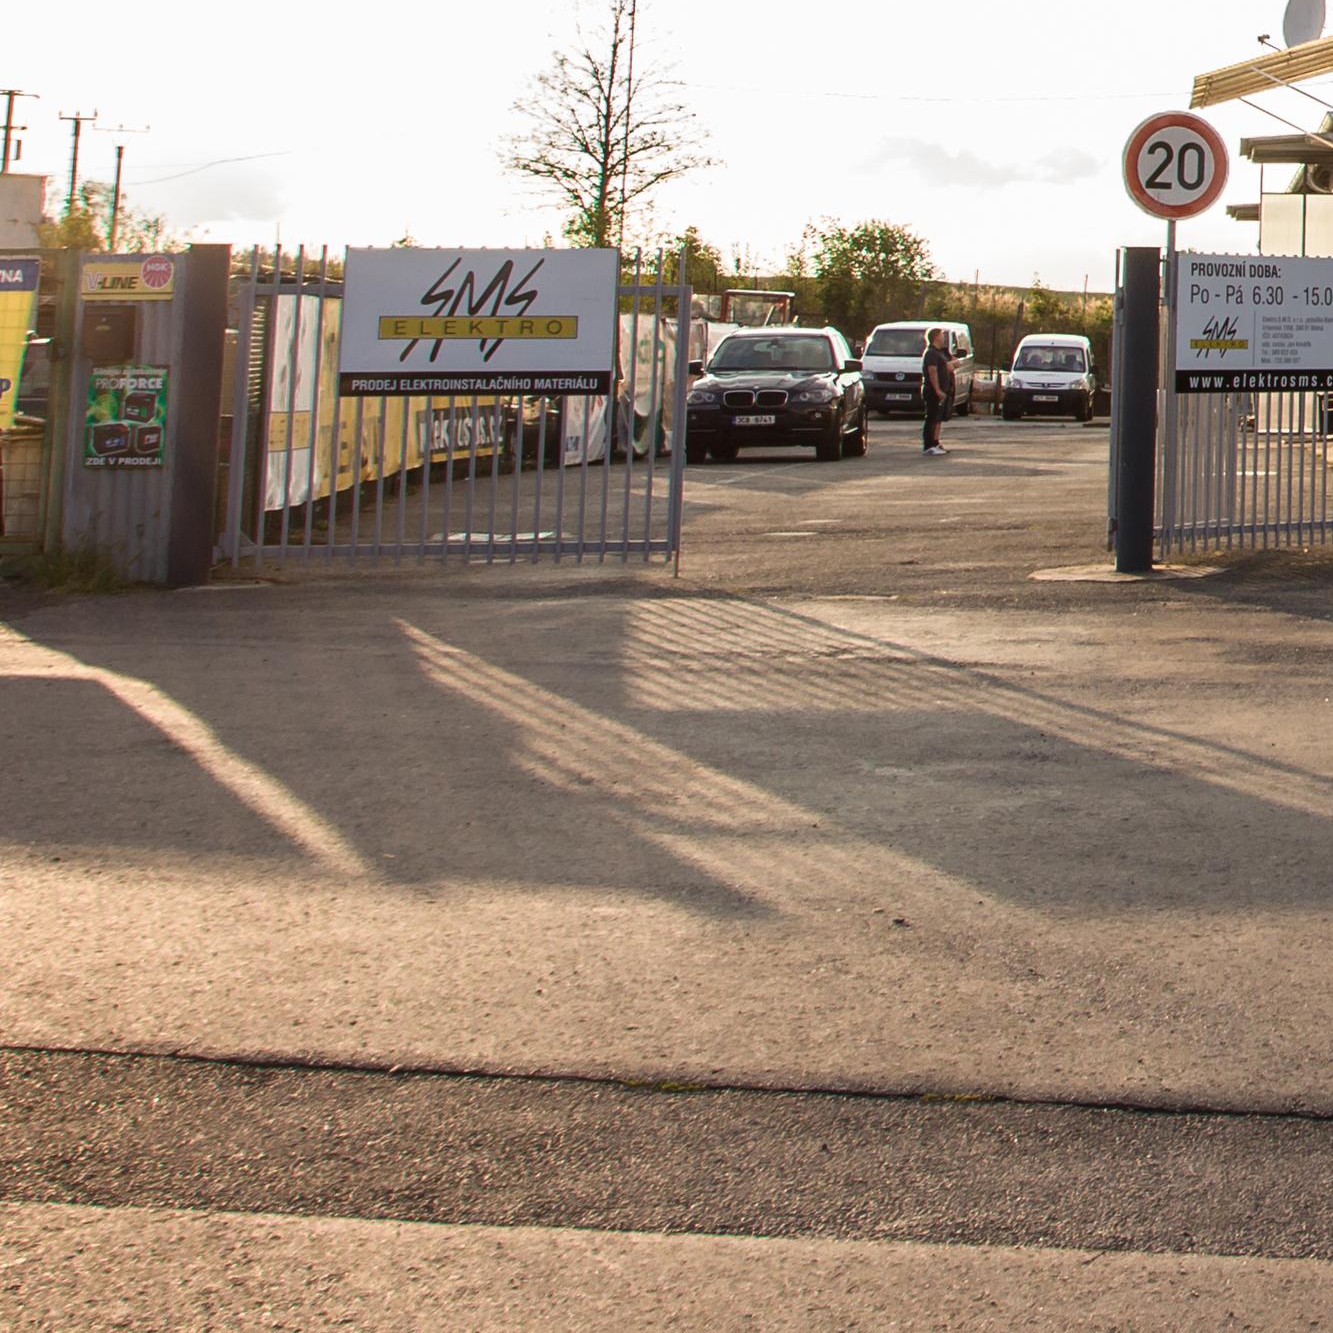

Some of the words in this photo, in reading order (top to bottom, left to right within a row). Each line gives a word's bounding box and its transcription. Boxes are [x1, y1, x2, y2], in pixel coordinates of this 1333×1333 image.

[1144, 140, 1206, 191] 20
[0, 263, 24, 284] NA
[1190, 260, 1247, 278] PROVOZNÍ
[1249, 264, 1282, 279] DOBA:
[1190, 284, 1210, 305] Po
[1225, 284, 1244, 305] Pá
[1252, 285, 1284, 306] 6.30
[399, 257, 545, 363] SMS
[394, 318, 564, 336] ELEKTRO
[1196, 315, 1239, 359] SMS
[95, 377, 164, 389] PROFORCE
[351, 378, 398, 392] PRODEJ
[400, 376, 532, 391] ELEKTROINSTALAČNÍHO
[534, 375, 599, 390] MATERIÁLU
[86, 457, 106, 466] ZDE
[107, 457, 116, 465] V
